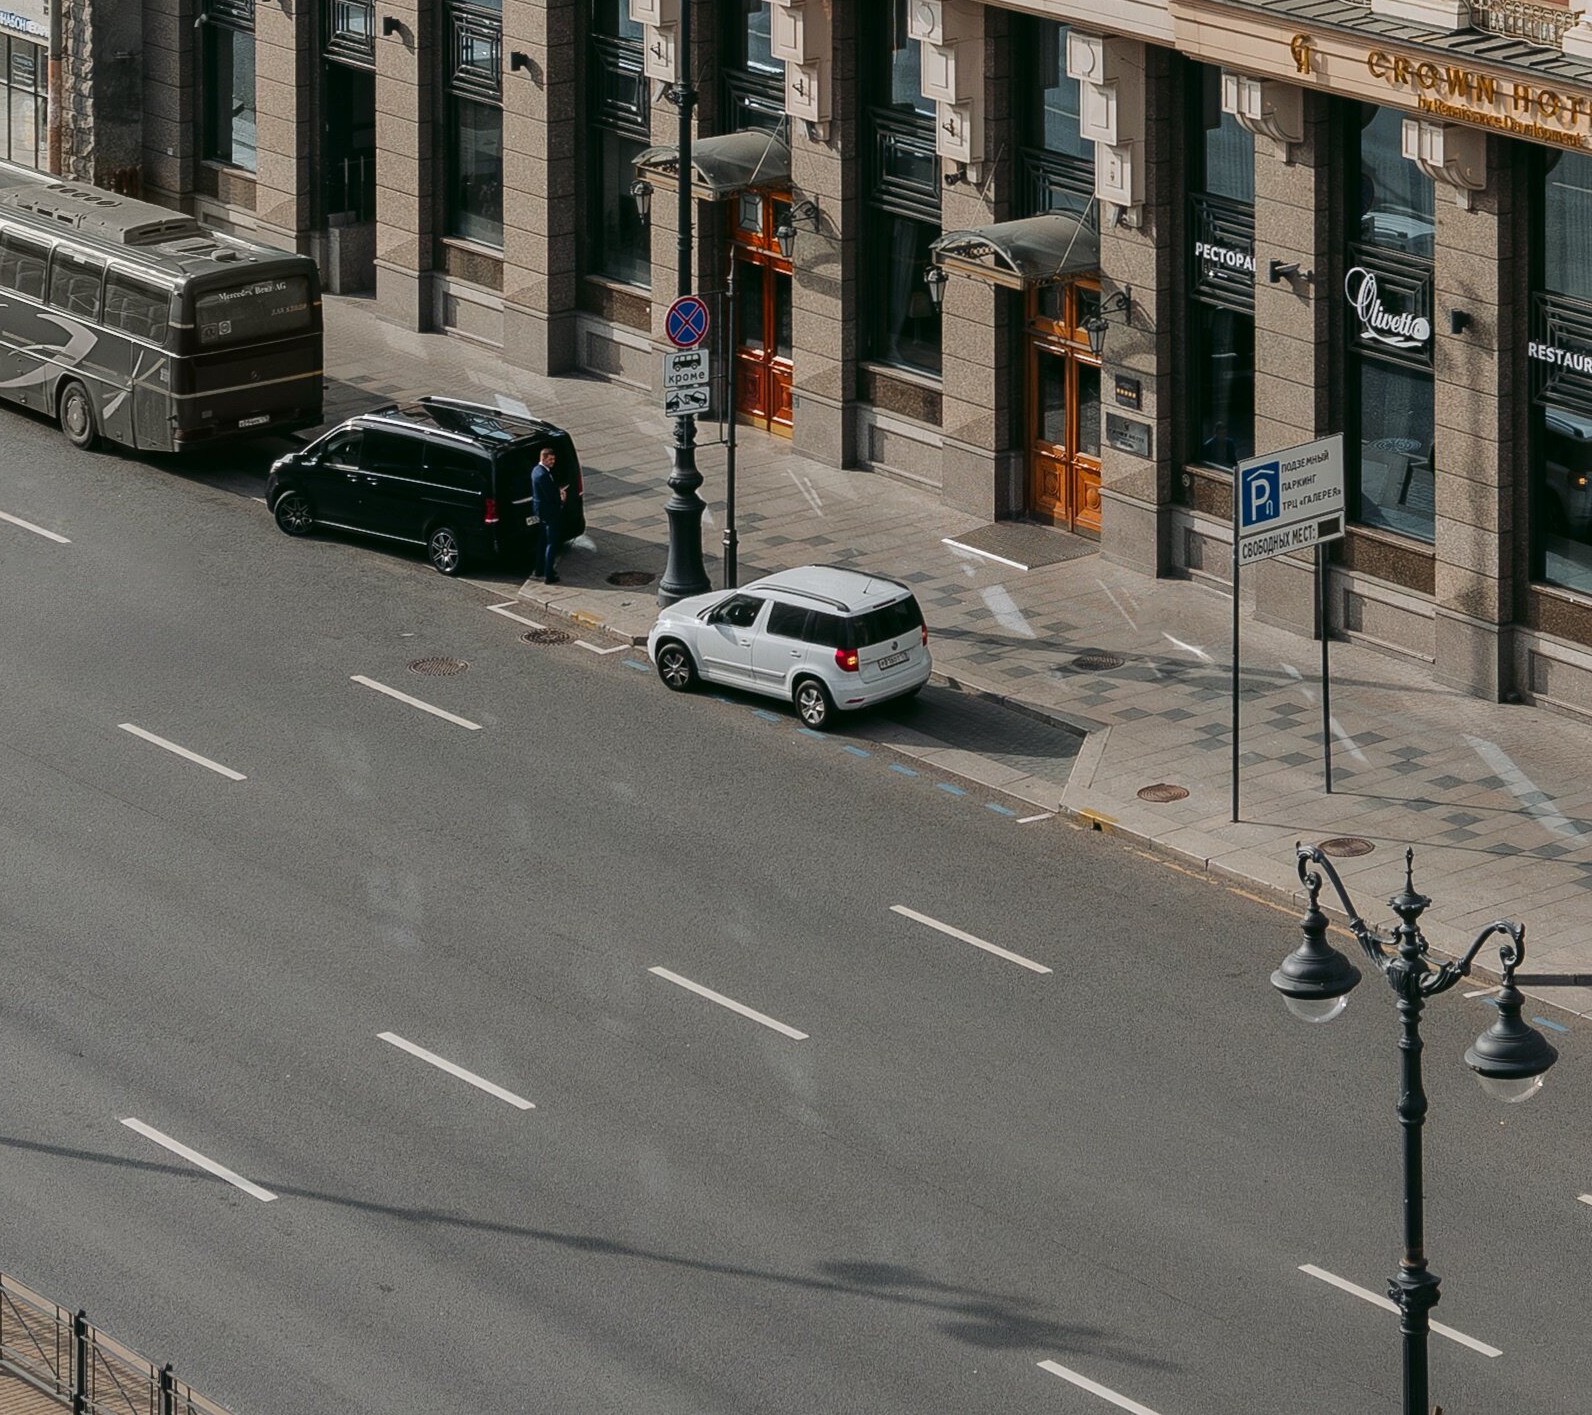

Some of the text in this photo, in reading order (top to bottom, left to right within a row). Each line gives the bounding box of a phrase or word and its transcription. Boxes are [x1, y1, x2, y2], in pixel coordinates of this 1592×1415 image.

[1367, 50, 1495, 104] CROWN
[1344, 266, 1431, 344] Olivetto
[668, 370, 706, 384] кроме
[1280, 449, 1329, 473] ПОДЗЕМНЫЙ
[1280, 473, 1317, 493] ПАРКИНГ
[1282, 486, 1342, 512] ТРЦ «ГАЛЕРЕЯ»
[1242, 524, 1316, 560] СВОБОДНЫХ МЕСТ:
